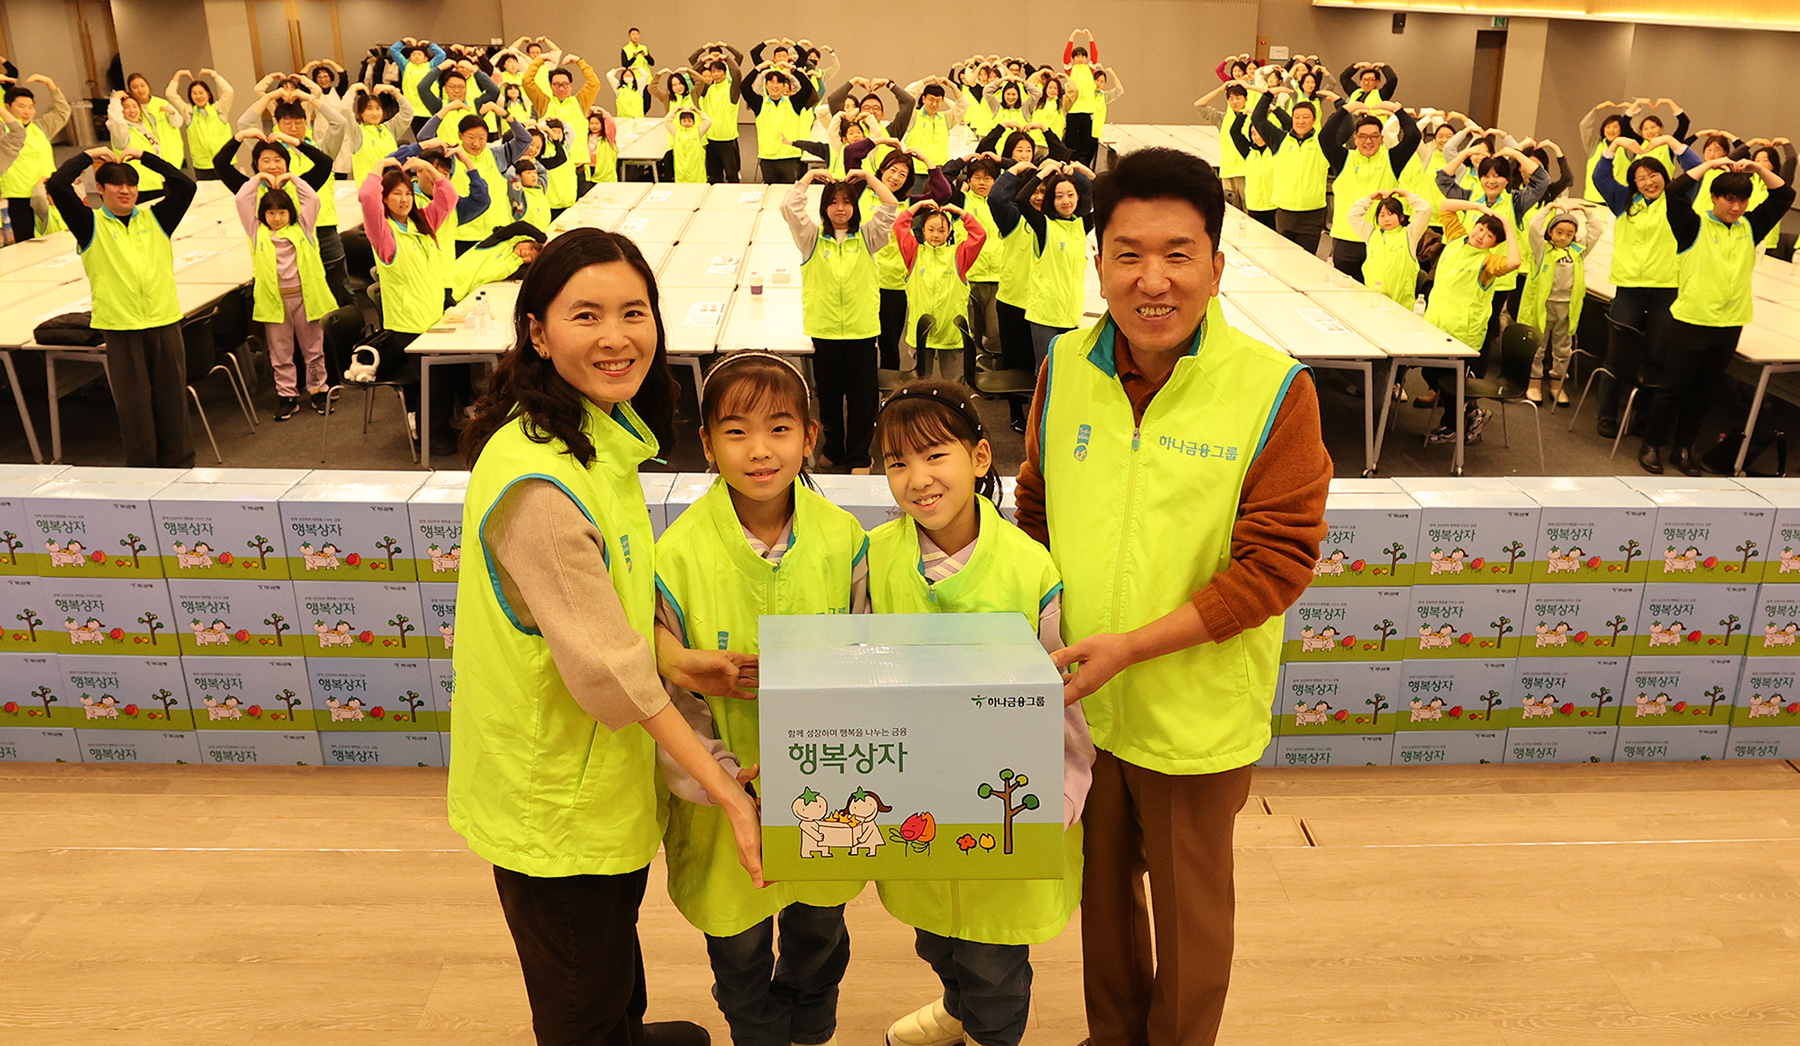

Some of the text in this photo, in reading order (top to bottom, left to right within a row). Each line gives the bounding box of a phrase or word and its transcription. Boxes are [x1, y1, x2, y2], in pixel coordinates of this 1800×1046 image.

[1160, 436, 1239, 461] 하나금융그룹
[36, 520, 85, 534] 행복상자
[164, 522, 213, 536] 행복상자
[292, 523, 342, 537] 행복상자
[1429, 529, 1475, 542] 행복상자
[1547, 528, 1593, 541] 행복상자
[1664, 528, 1709, 541] 행복상자
[55, 599, 104, 612] 행복상자
[181, 600, 230, 614] 행복상자
[306, 602, 355, 615] 행복상자
[1417, 606, 1464, 618] 행복상자
[1535, 604, 1579, 616] 행복상자
[1650, 604, 1693, 616] 행복상자
[1765, 605, 1800, 617] 행복상
[1299, 606, 1346, 620] 행복상자
[71, 676, 118, 689] 행복상자
[195, 678, 242, 690] 행복상자
[319, 678, 366, 691] 행복상자
[1408, 679, 1453, 692] 행복상자
[1522, 677, 1566, 689] 행복상자
[1636, 676, 1679, 688] 행복상자
[1750, 677, 1793, 689] 행복상자
[1292, 683, 1338, 696] 행복상자
[987, 696, 1046, 709] 하나금융그룹
[788, 726, 908, 738] 함께 성장하며 행복을 나누는 금융
[90, 749, 136, 760] 행복상자
[210, 749, 256, 762] 행복상자
[332, 749, 378, 763] 행복상자
[789, 741, 908, 775] 행복상자
[1401, 751, 1445, 762] 행복상자
[1514, 748, 1556, 759] 행복상자
[1624, 746, 1667, 757] 행복상자
[1735, 746, 1777, 757] 행복상자
[1286, 752, 1330, 765] 행복상자
